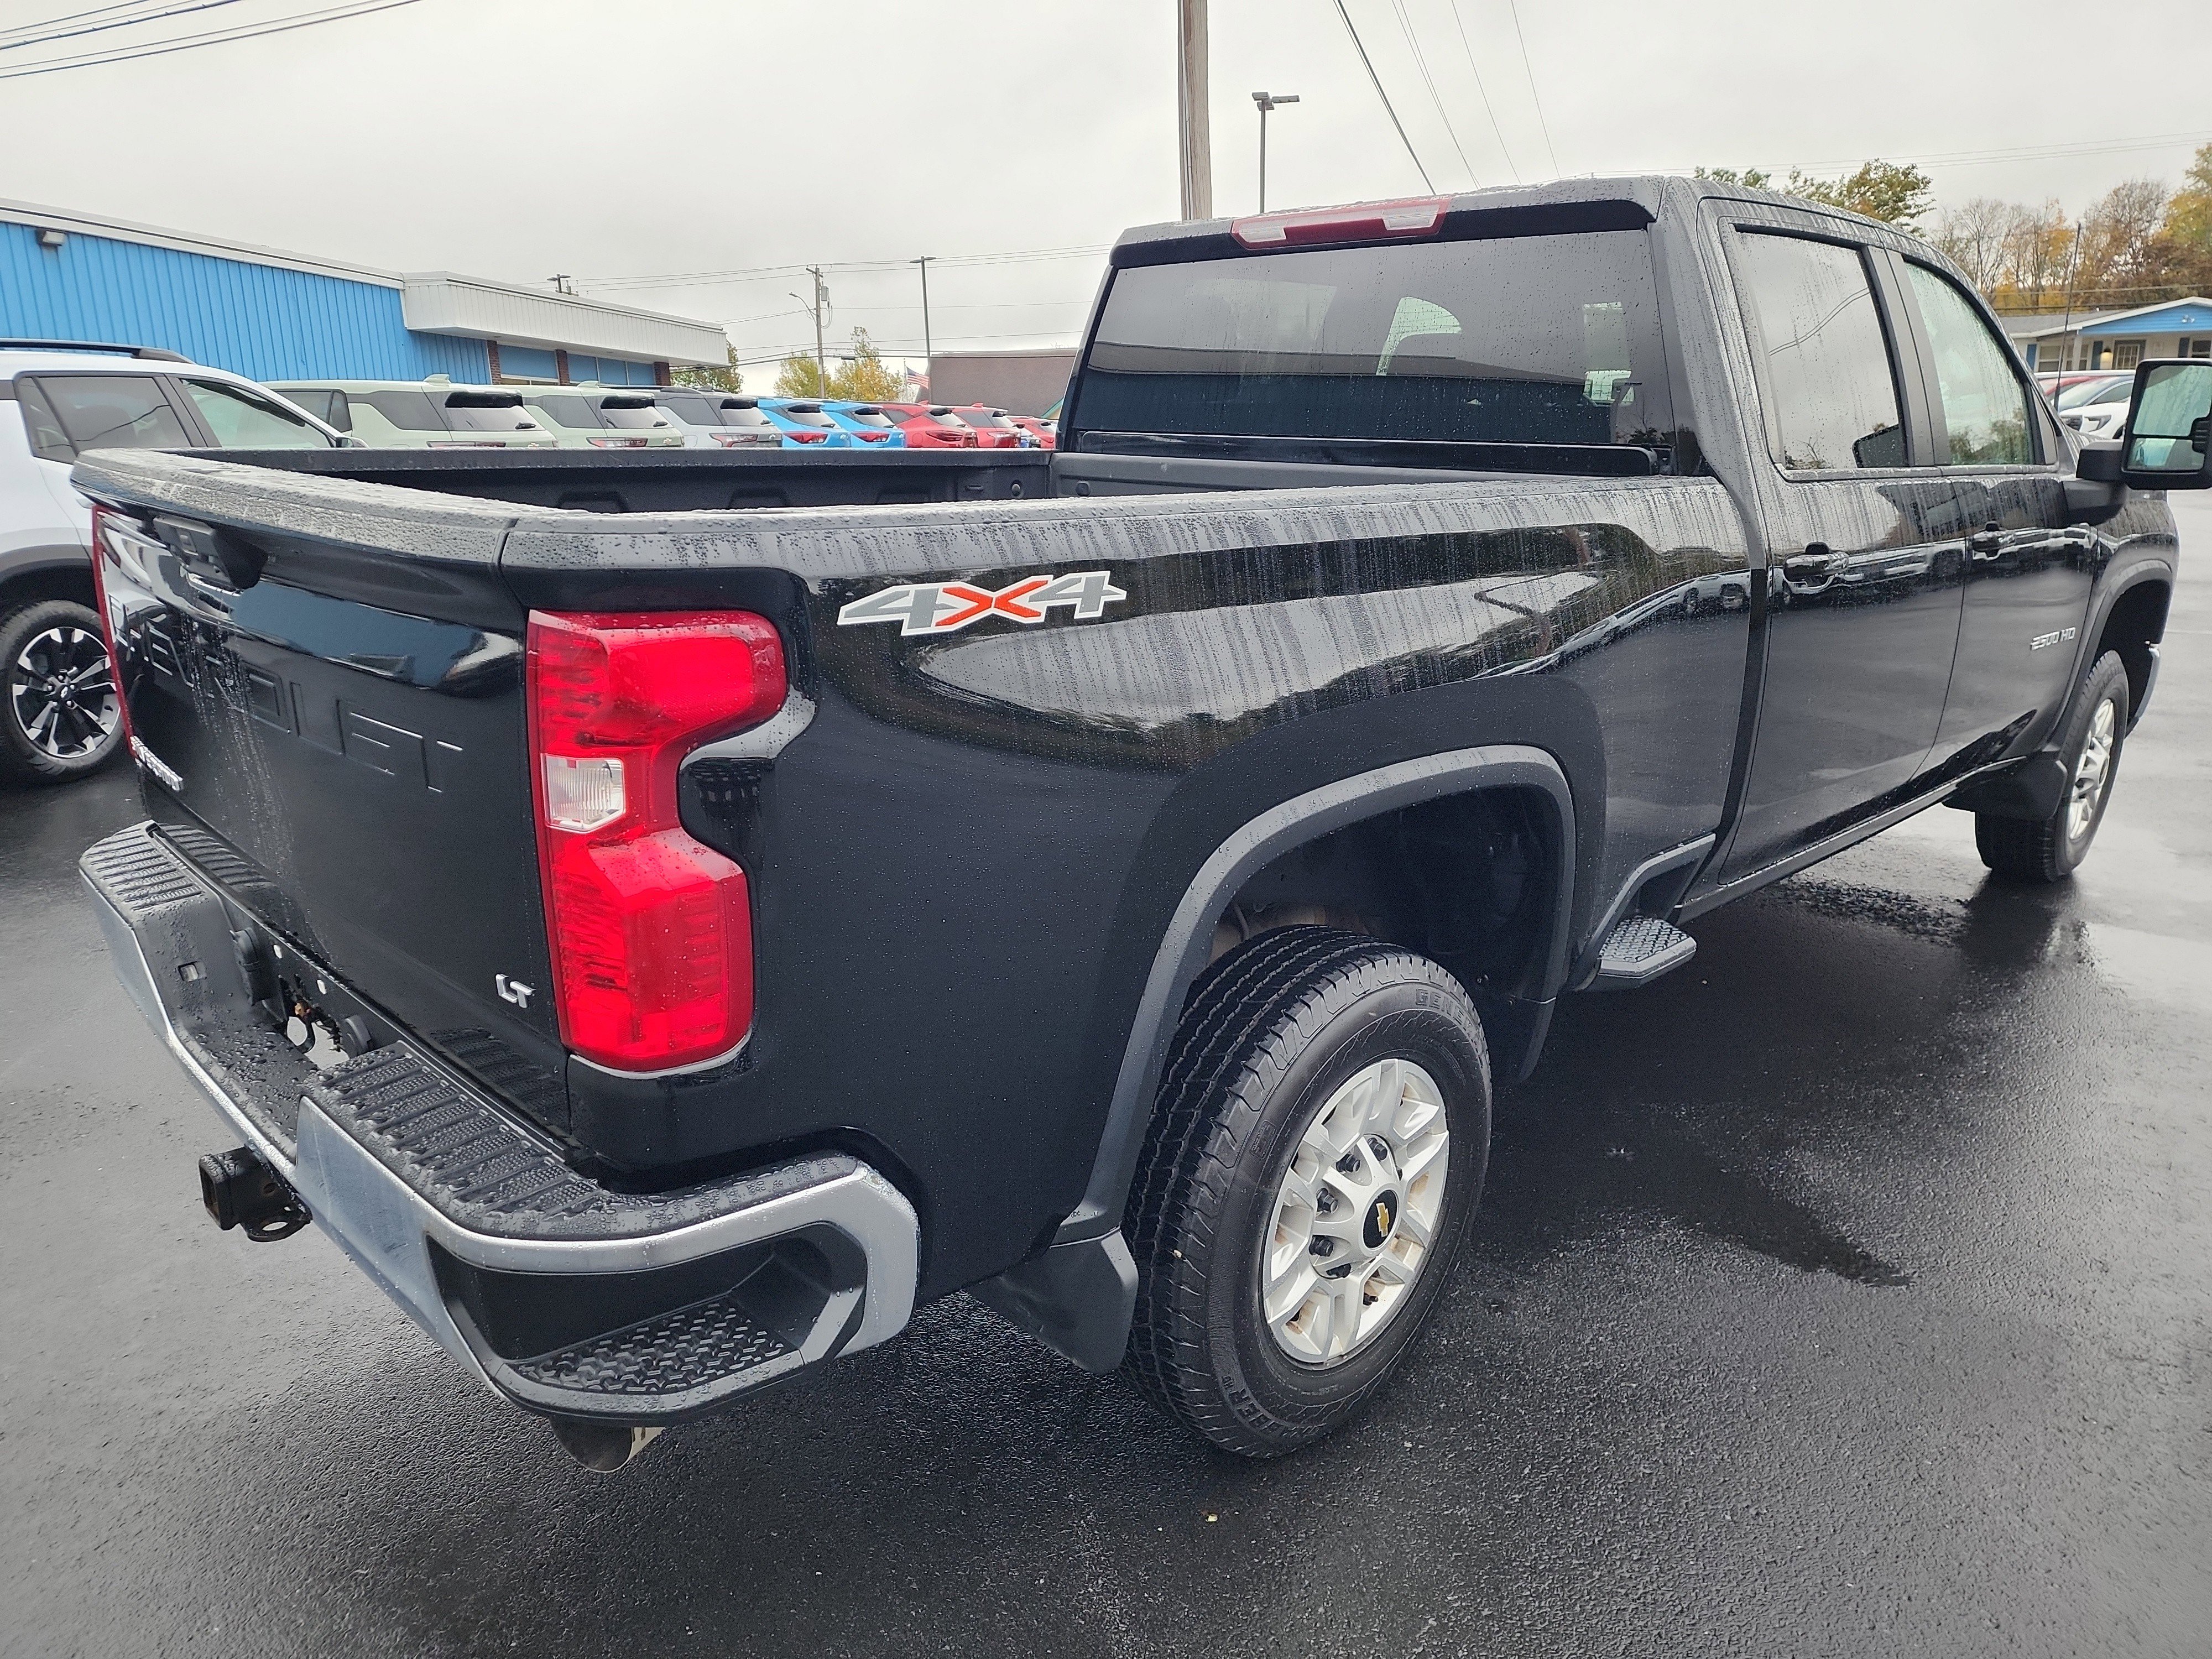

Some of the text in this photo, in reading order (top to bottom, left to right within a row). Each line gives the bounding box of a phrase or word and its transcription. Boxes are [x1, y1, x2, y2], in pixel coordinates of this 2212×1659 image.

[2030, 627, 2076, 650] 2500 HD
[495, 973, 534, 1008] LT
